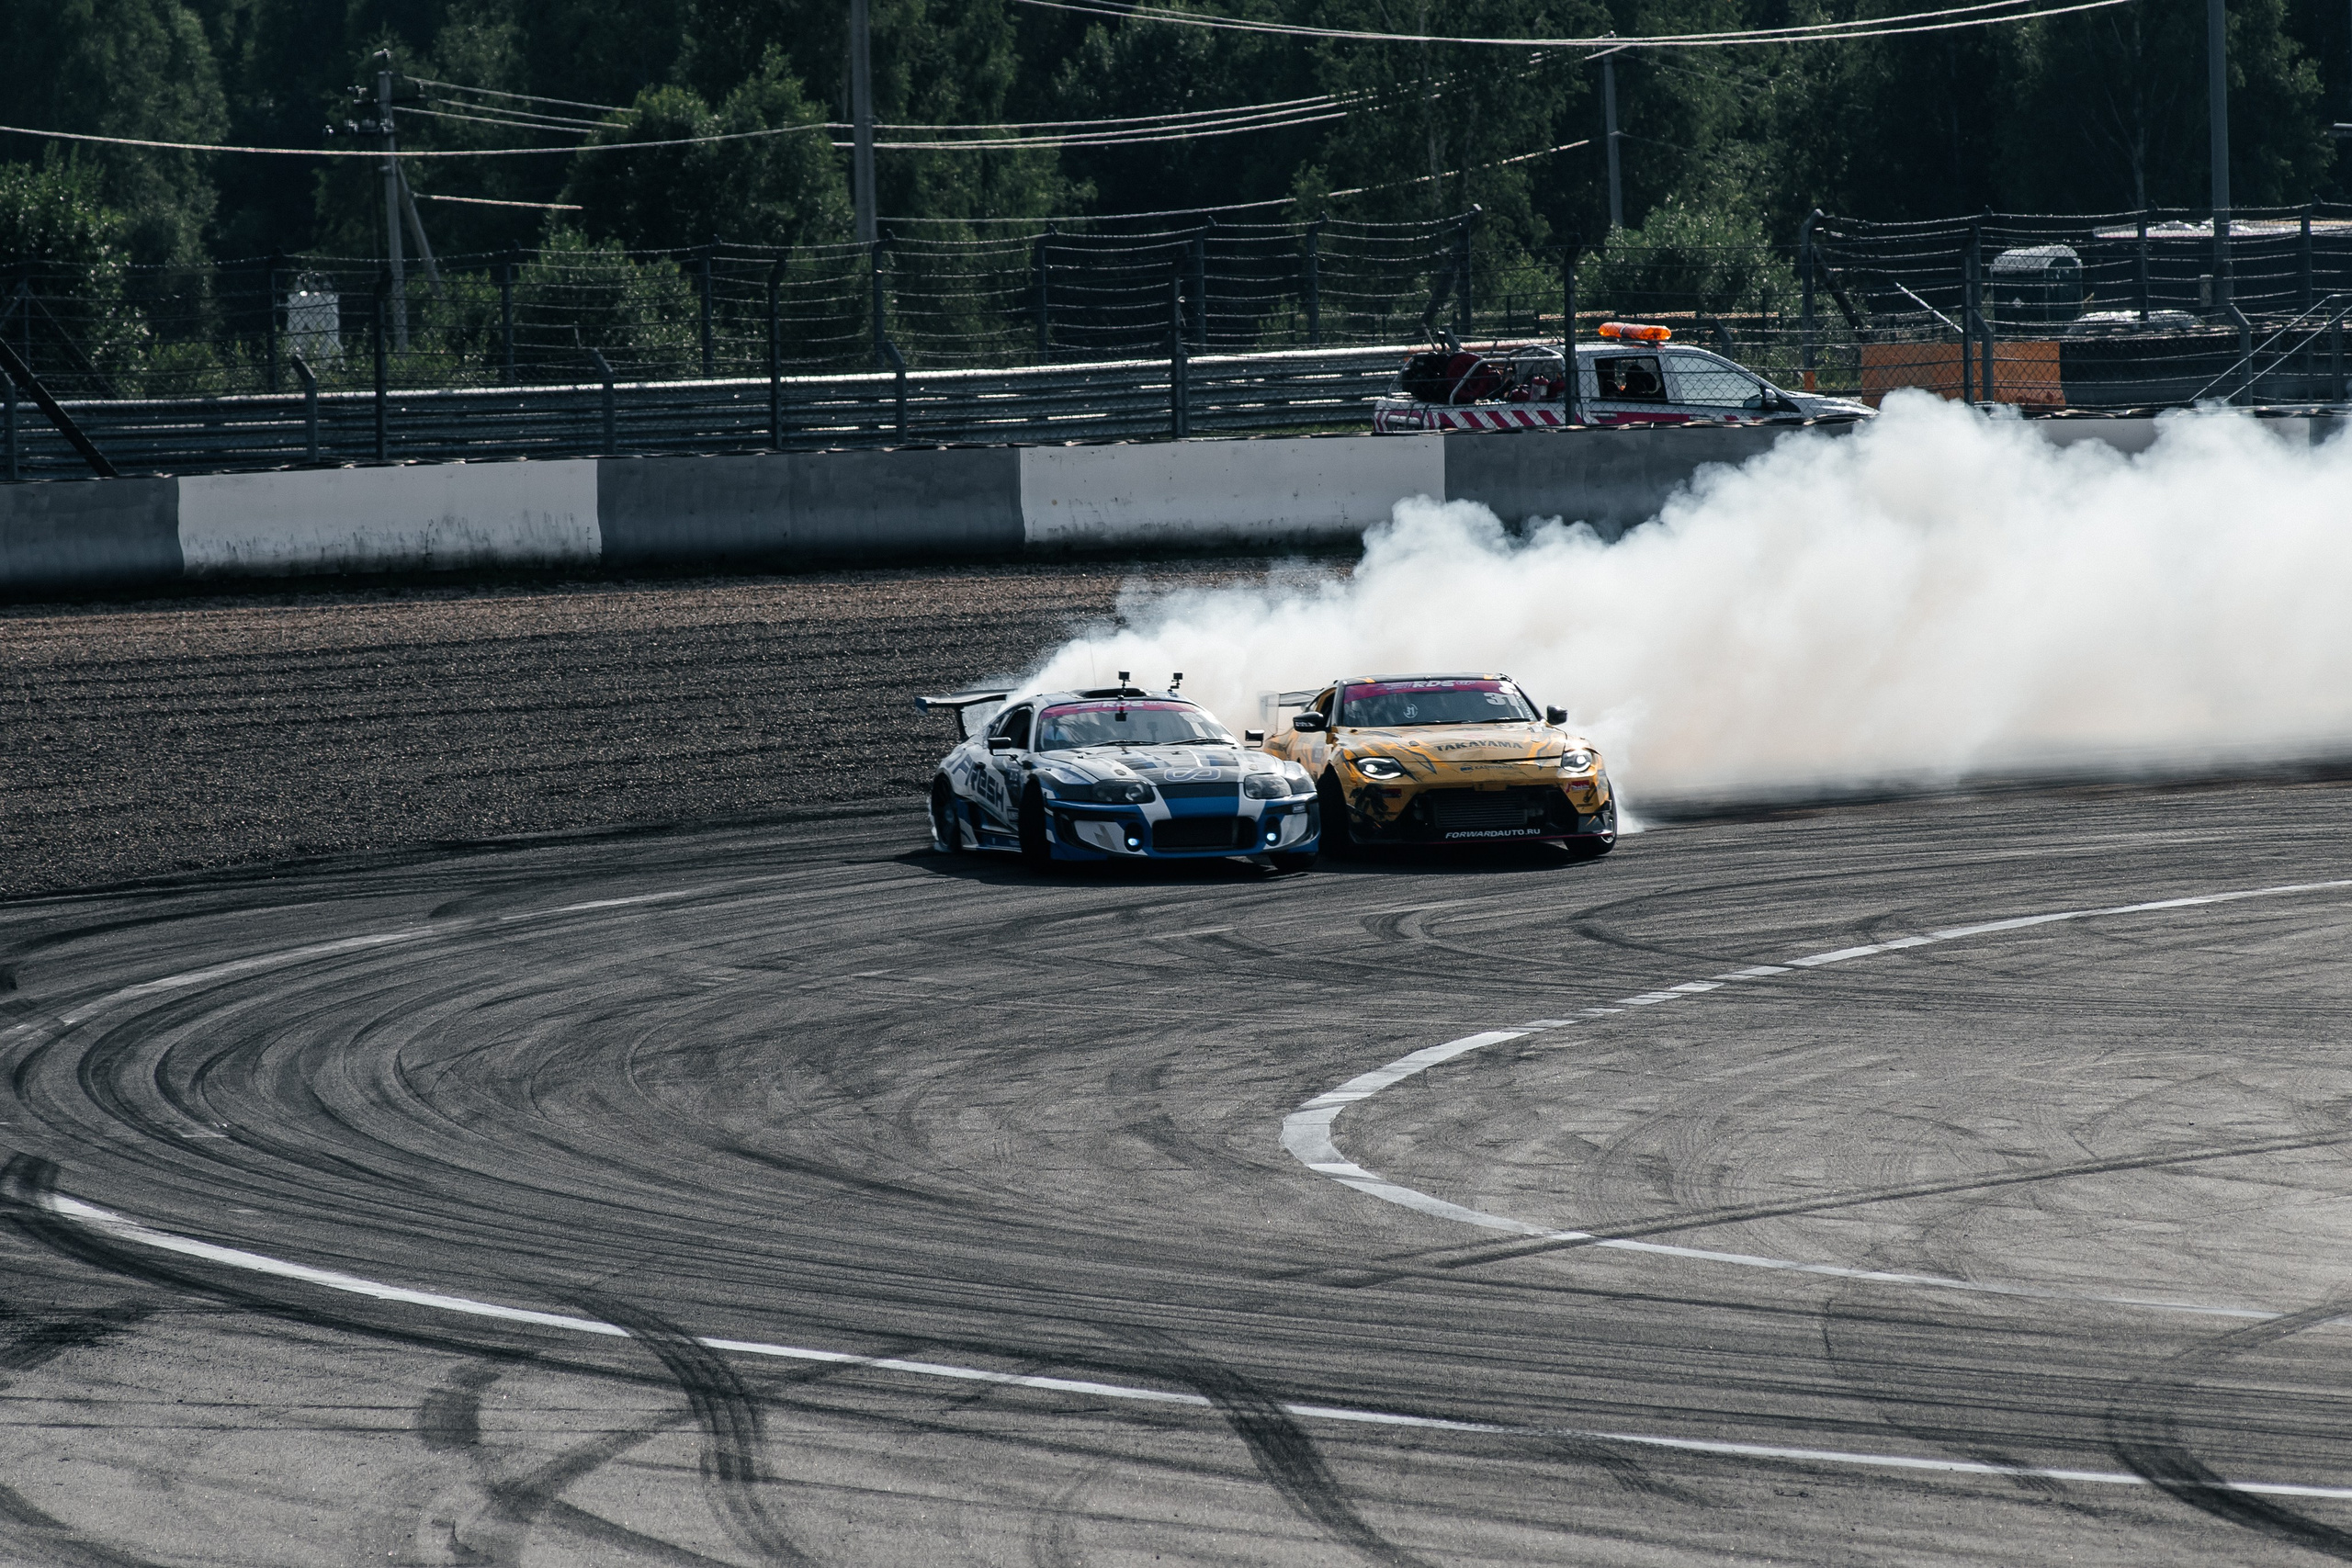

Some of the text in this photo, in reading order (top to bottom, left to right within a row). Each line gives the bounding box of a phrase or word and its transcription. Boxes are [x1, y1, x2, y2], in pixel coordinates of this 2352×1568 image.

[1412, 680, 1456, 688] RDS
[1102, 700, 1145, 708] RDS
[1484, 692, 1519, 706] 31
[1406, 706, 1415, 716] 31
[1434, 740, 1523, 752] TAKAYAMA
[1445, 829, 1541, 840] FORWARDAUTO.RU
